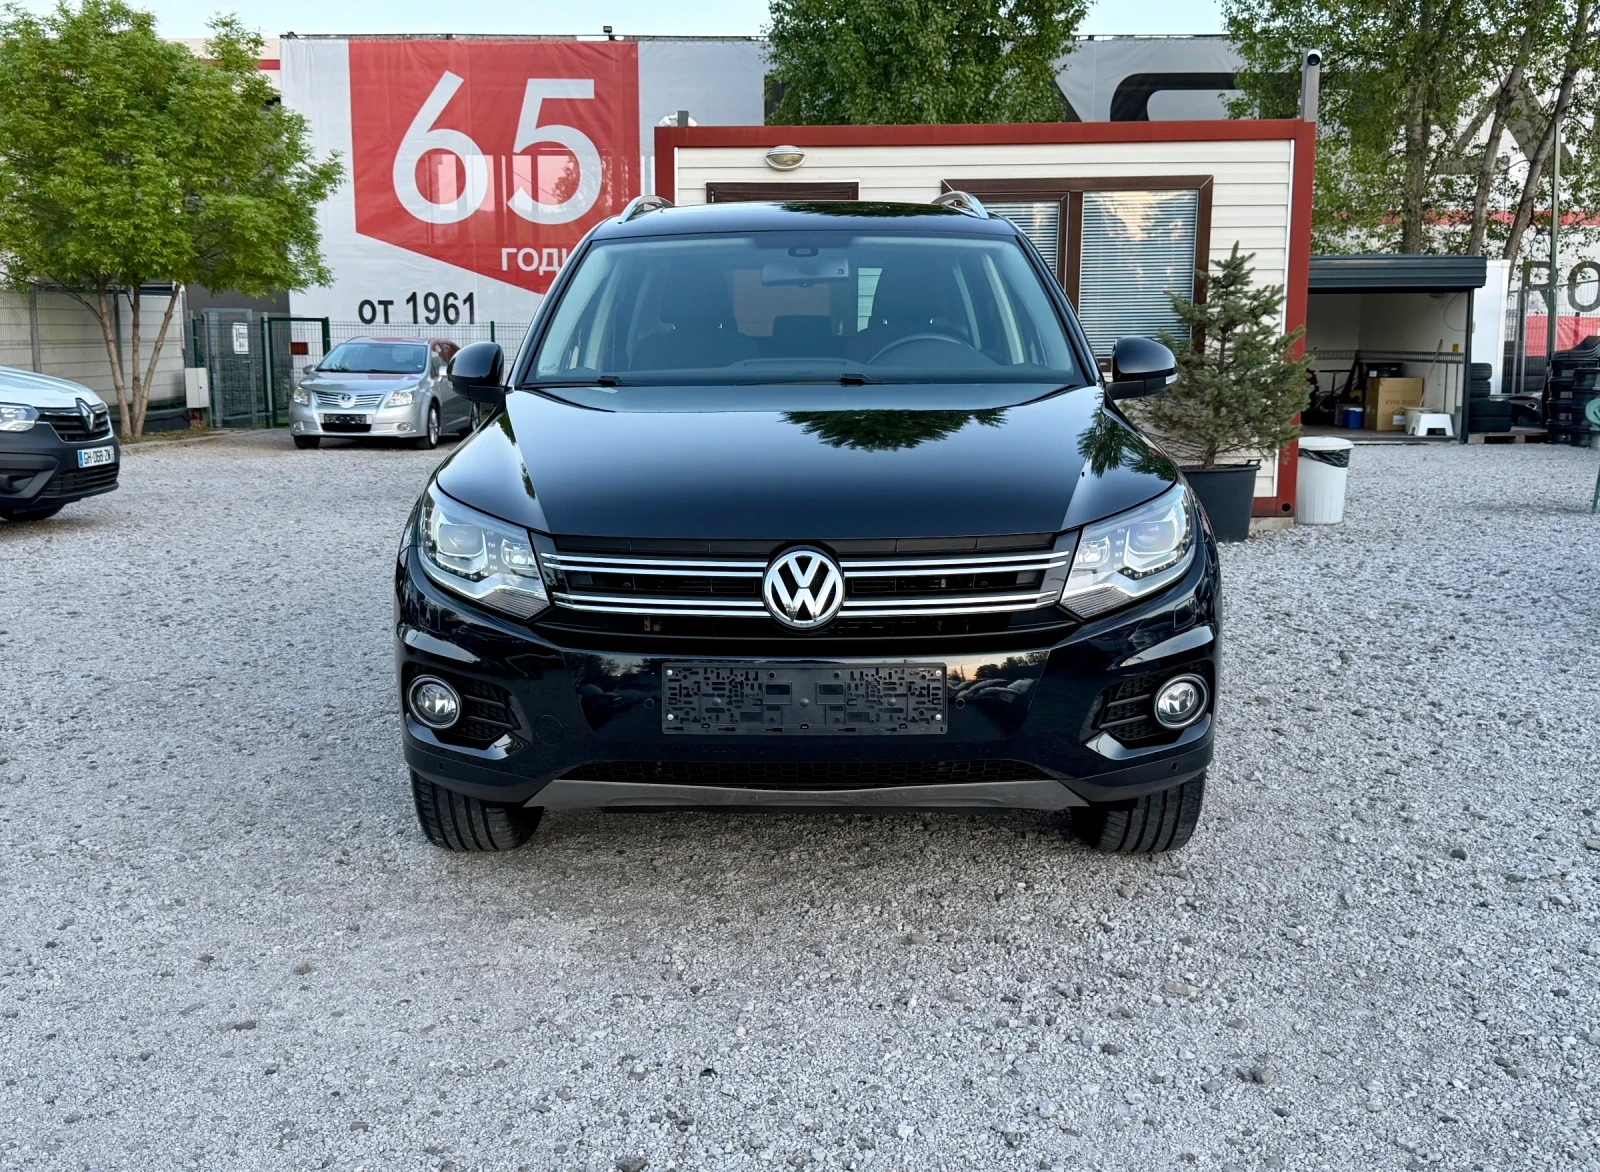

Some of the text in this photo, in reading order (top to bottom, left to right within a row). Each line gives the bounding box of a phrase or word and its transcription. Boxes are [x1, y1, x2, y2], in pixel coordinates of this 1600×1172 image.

[392, 69, 603, 225] 65
[405, 291, 476, 326] 1961
[764, 550, 843, 626] VW
